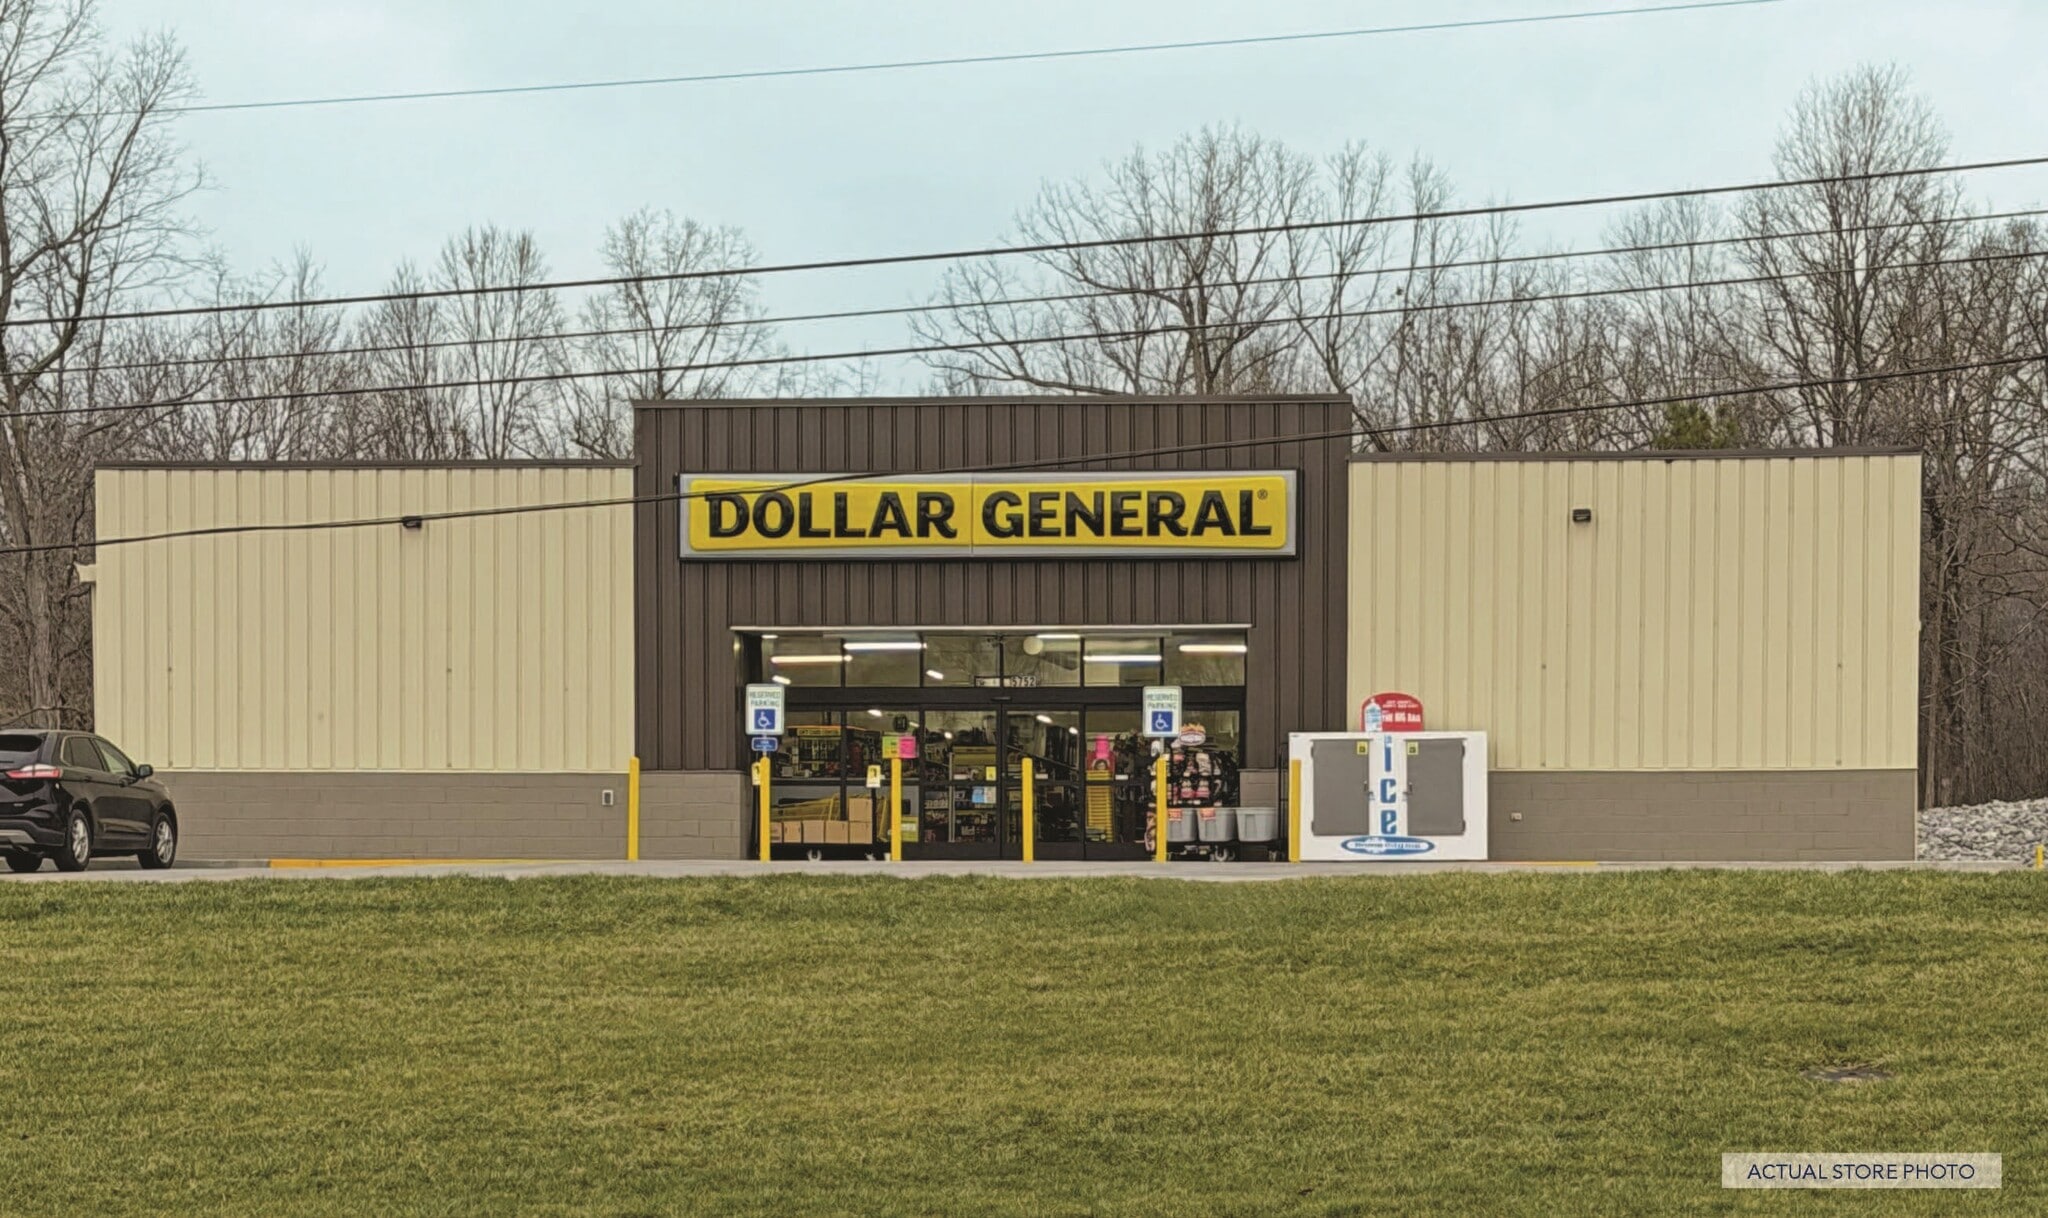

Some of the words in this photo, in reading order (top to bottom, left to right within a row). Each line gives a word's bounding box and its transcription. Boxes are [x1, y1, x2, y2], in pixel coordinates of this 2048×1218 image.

[704, 491, 958, 539] DOLLAR
[981, 489, 1272, 539] GENERAL
[748, 691, 782, 699] RESERVED
[1146, 693, 1179, 701] RESERVED
[750, 700, 781, 708] PARKING
[1147, 702, 1177, 710] PARKING
